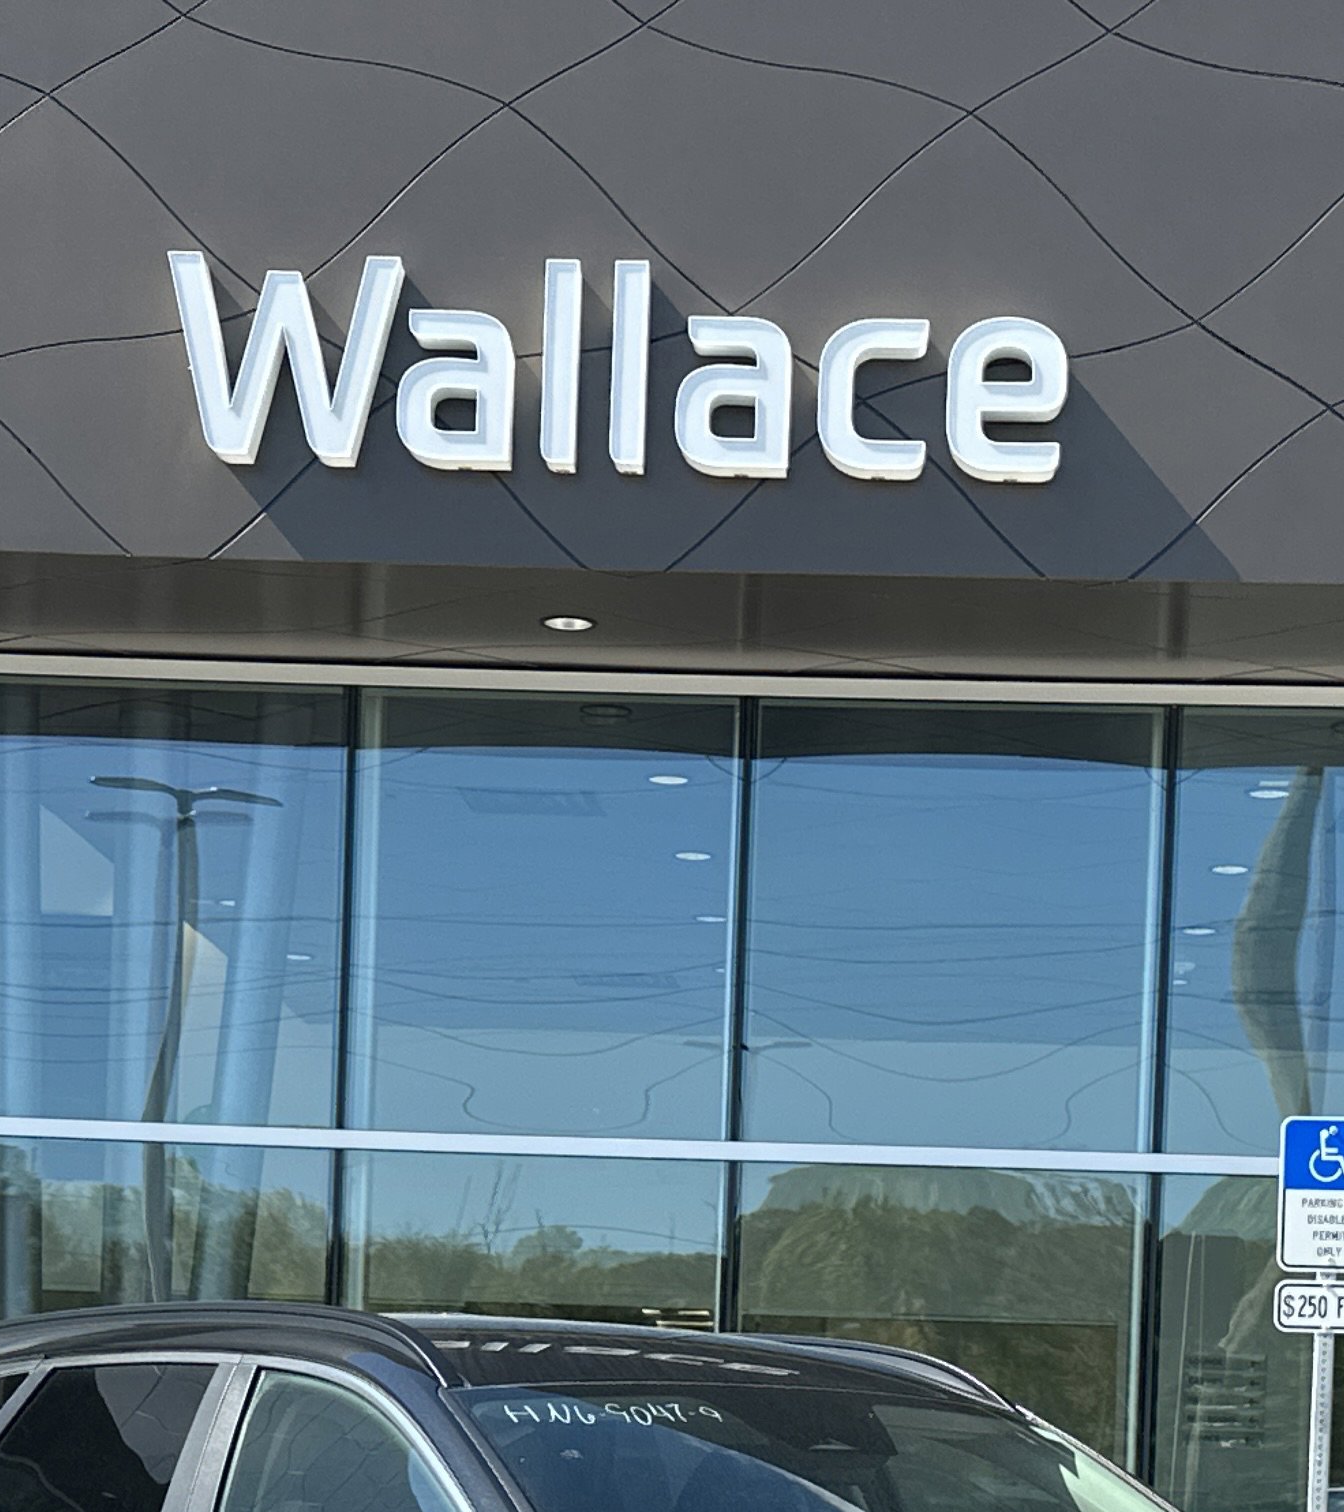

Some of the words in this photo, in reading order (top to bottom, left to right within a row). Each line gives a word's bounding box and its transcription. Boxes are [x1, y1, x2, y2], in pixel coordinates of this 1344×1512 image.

[167, 249, 1068, 482] Wallace
[1301, 1198, 1343, 1208] PARKING
[1316, 1246, 1343, 1257] ONLY
[1283, 1294, 1328, 1320] $250
